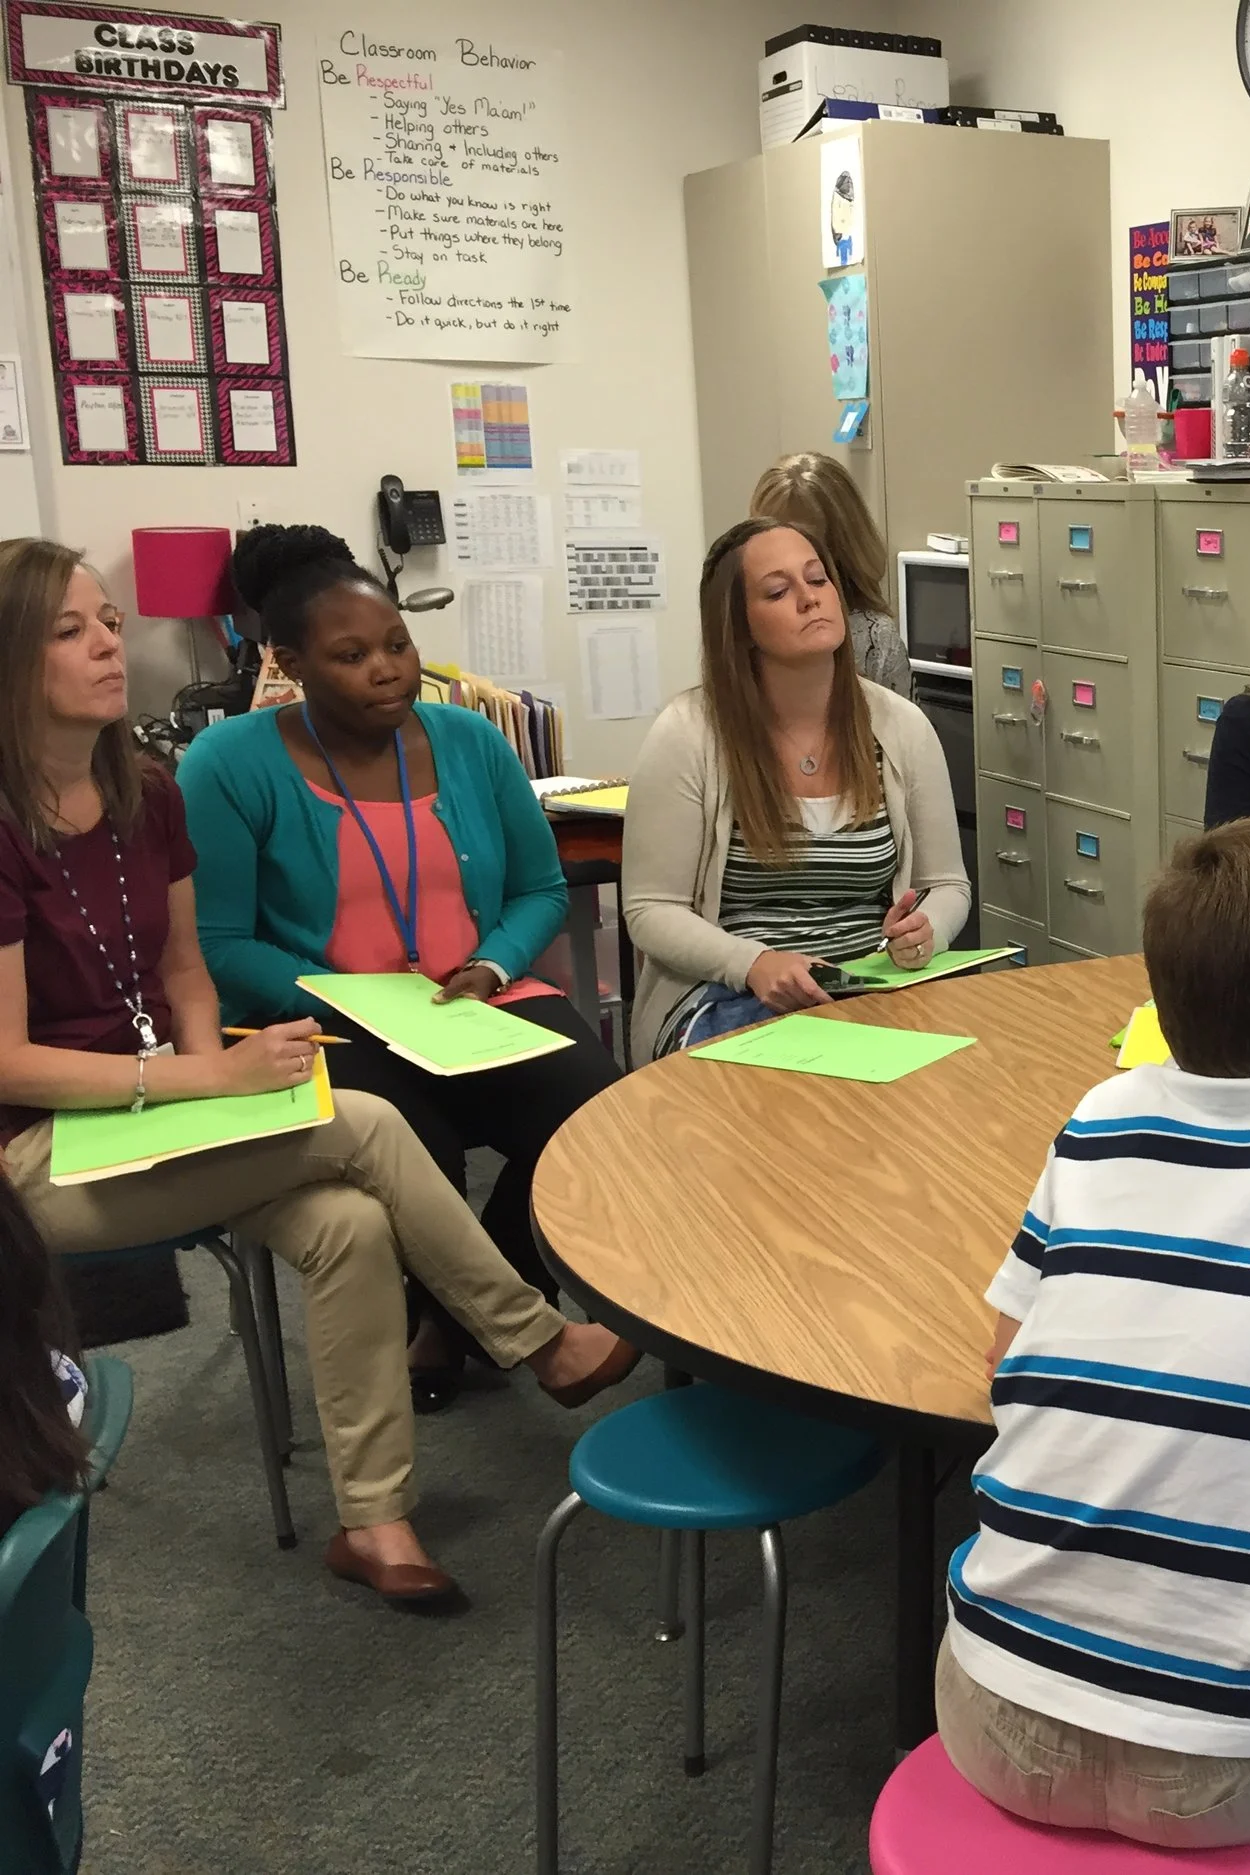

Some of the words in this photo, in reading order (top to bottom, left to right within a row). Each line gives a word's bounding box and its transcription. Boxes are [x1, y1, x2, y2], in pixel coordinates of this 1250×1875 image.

[94, 23, 195, 56] CLASS
[340, 30, 436, 61] Classroom
[456, 38, 536, 71] Behavior
[320, 59, 351, 85] Be
[356, 63, 433, 91] Respectful
[384, 91, 427, 118] Saying
[385, 113, 434, 141] Helping
[443, 122, 489, 137] others
[385, 132, 442, 160] Sharing
[464, 139, 517, 168] Including
[524, 146, 559, 163] others
[385, 151, 414, 166] Take
[421, 157, 449, 169] care
[461, 159, 476, 170] of
[481, 163, 540, 176] materials
[330, 157, 355, 180] Be
[364, 157, 453, 187] Responsible
[385, 186, 405, 201] Do
[410, 189, 441, 203] what
[446, 195, 464, 210] you
[467, 196, 498, 210] know
[503, 201, 515, 211] is
[521, 202, 552, 220] right
[387, 205, 427, 222] Make
[432, 211, 461, 224] sure
[466, 214, 517, 230] materials
[521, 219, 538, 230] are
[542, 218, 564, 233] here
[389, 224, 415, 241] Put
[420, 228, 460, 250] things
[464, 231, 499, 246] where
[502, 231, 524, 250] they
[528, 233, 562, 257] belong
[392, 245, 424, 263] Stay
[432, 252, 448, 262] on
[455, 249, 488, 264] task
[339, 259, 370, 284] Be
[377, 260, 427, 291] Ready
[398, 289, 442, 307] Follow
[447, 294, 503, 311] directions
[508, 295, 525, 309] the
[530, 297, 546, 311] 1st
[549, 301, 572, 313] time
[1134, 297, 1150, 315] Be
[396, 310, 415, 327] Do
[420, 315, 430, 326] it
[475, 317, 497, 329] but
[503, 318, 515, 330] do
[519, 318, 529, 330] it
[533, 320, 560, 337] right
[1134, 320, 1147, 339] Be
